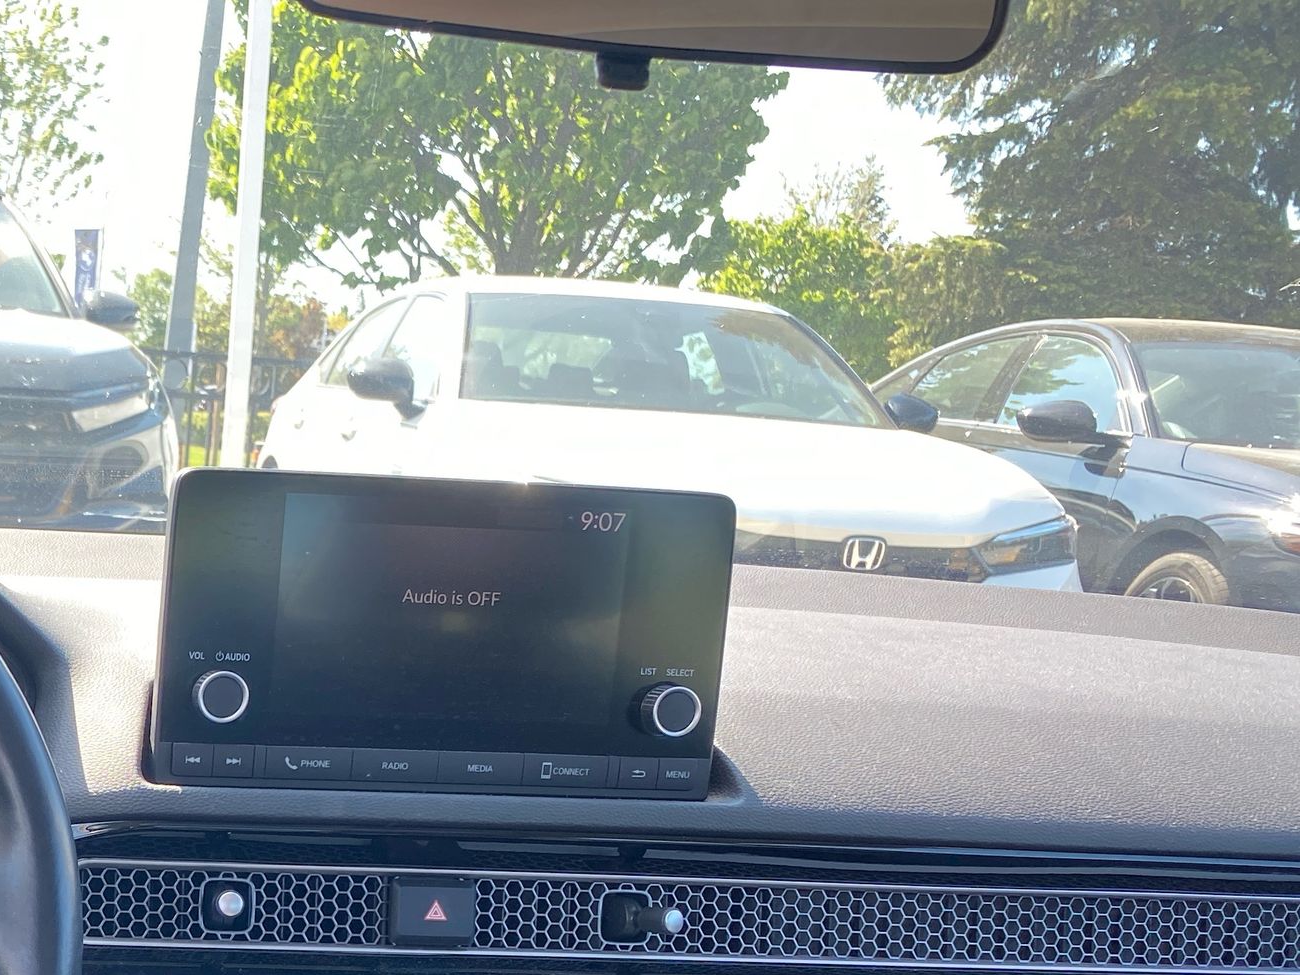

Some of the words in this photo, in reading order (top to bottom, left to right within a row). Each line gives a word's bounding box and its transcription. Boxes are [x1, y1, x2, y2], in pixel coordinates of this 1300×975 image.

[580, 511, 627, 532] 9:07
[402, 589, 447, 605] Audio
[451, 590, 463, 606] is
[467, 591, 501, 607] OFF
[188, 651, 205, 660] VOL
[224, 652, 251, 662] AUDIO
[640, 667, 657, 676] LIST
[665, 668, 695, 678] SELECT
[300, 759, 331, 769] PHONE
[381, 761, 409, 771] RADIO
[467, 763, 494, 774] MEDIA
[552, 766, 591, 777] CONNECT
[665, 770, 691, 780] MENU
